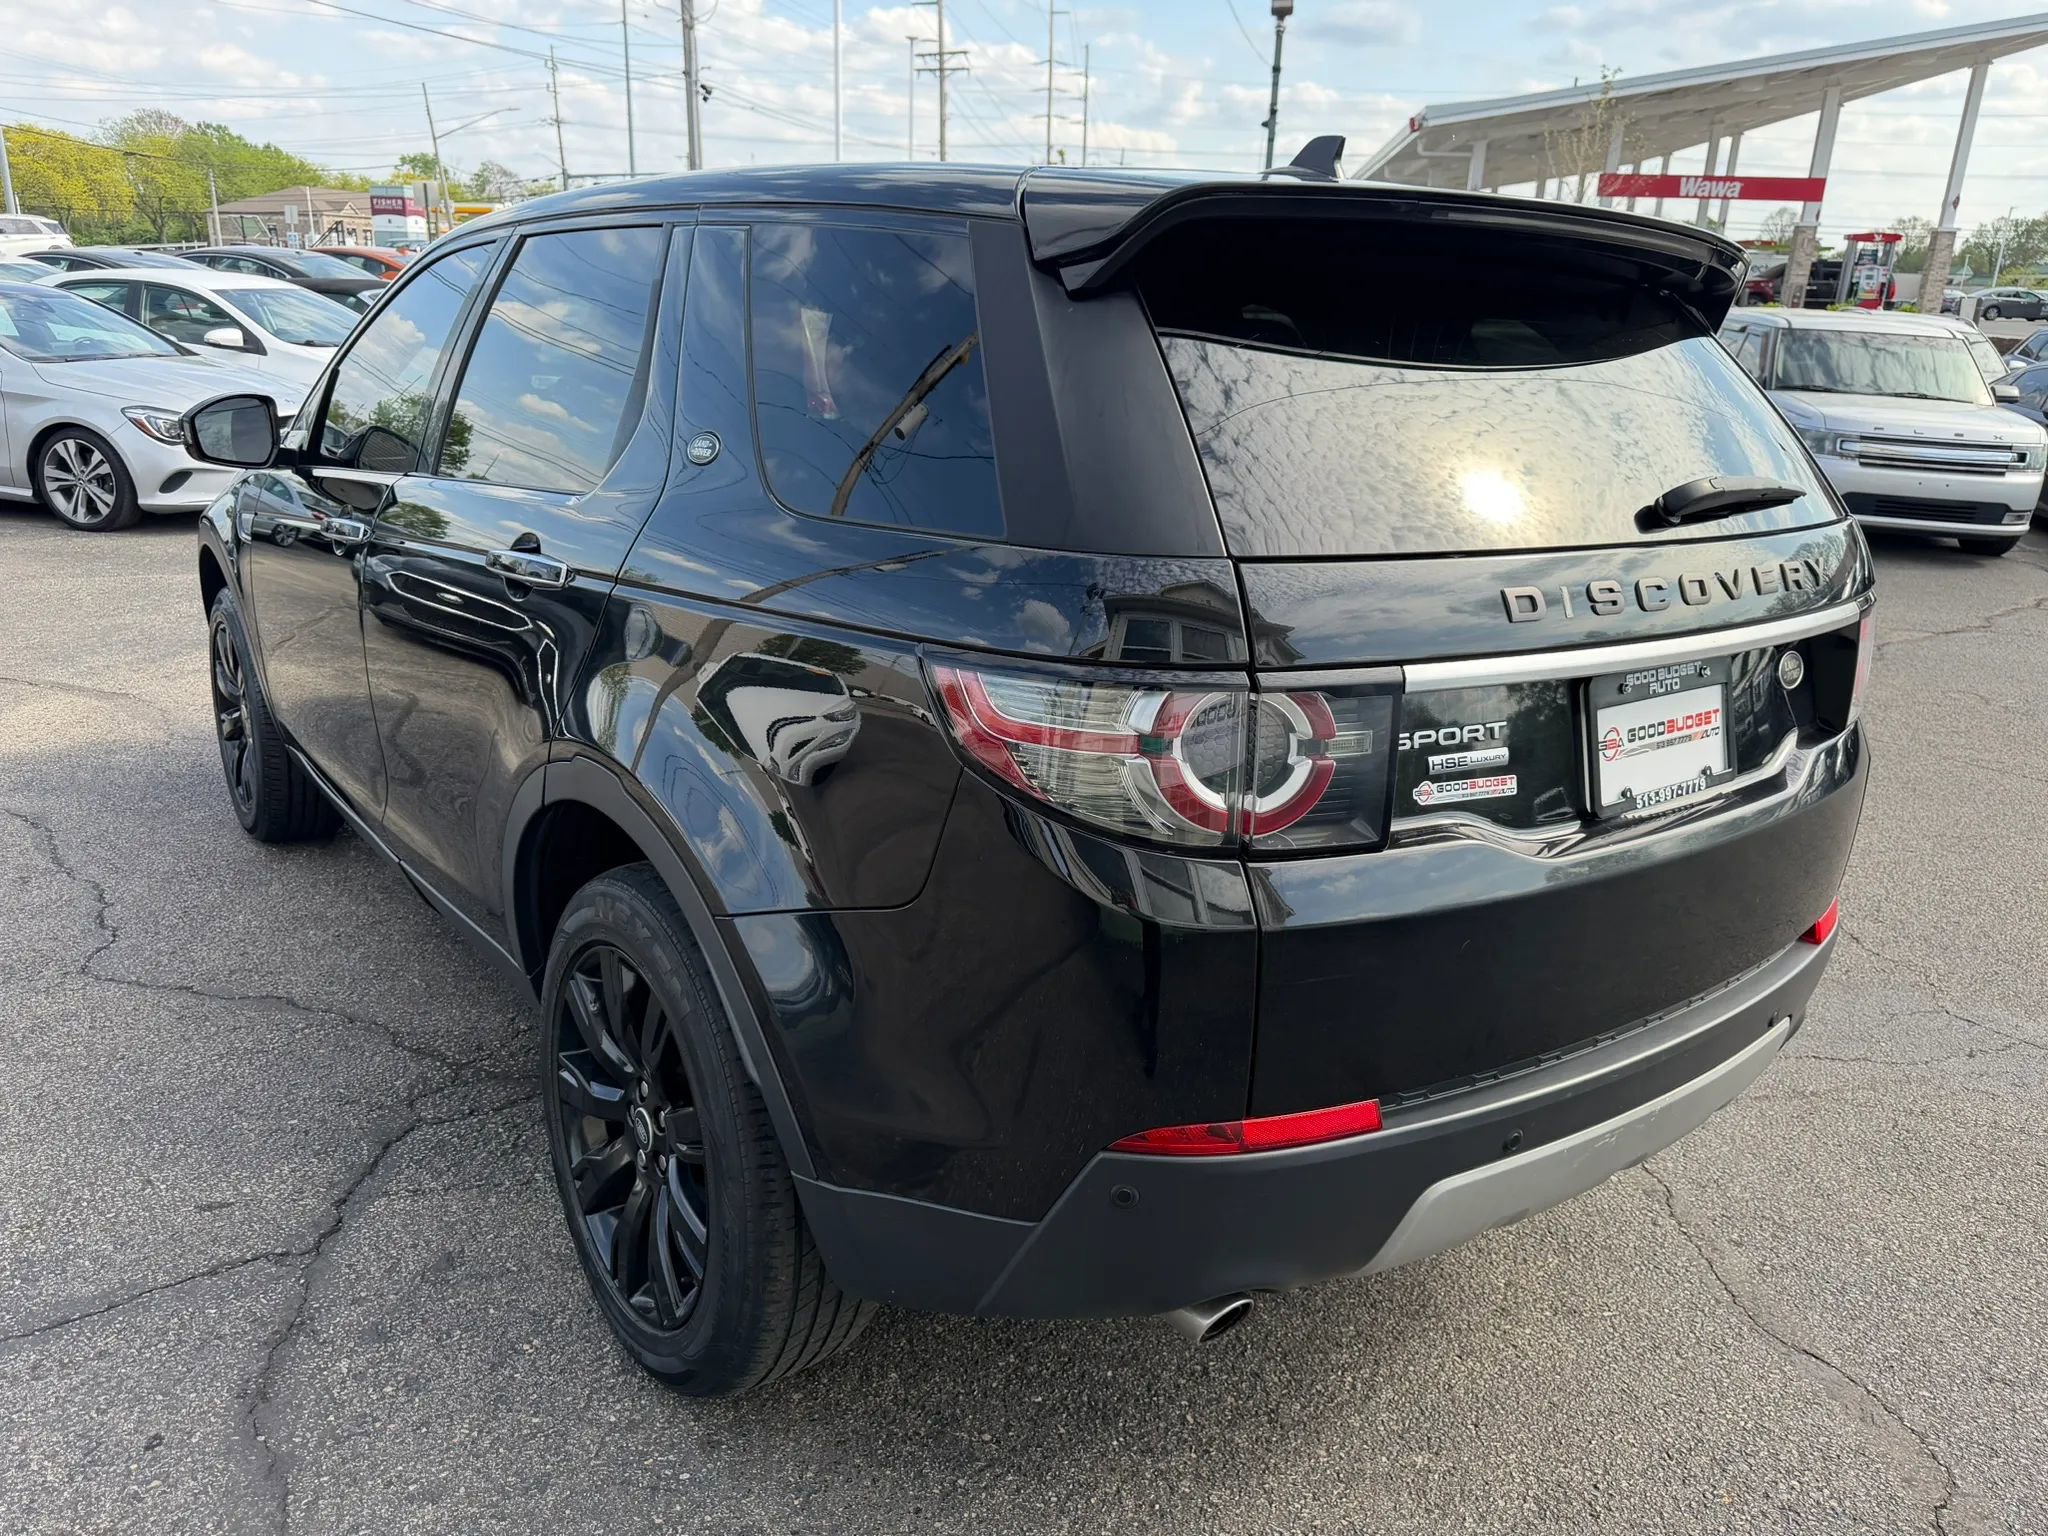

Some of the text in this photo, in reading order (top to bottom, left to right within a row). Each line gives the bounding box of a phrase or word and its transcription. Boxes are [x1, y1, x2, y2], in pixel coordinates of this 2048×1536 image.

[1679, 177, 1741, 198] Wawa
[1500, 557, 1825, 623] DISCOVERY
[1625, 661, 1702, 686] GOOD BUDGET
[1649, 678, 1681, 695] AUTO
[1398, 721, 1507, 750] SPORT
[1627, 709, 1720, 743] GOODBUDGET
[1431, 753, 1507, 771] HSE LUXURY
[1436, 776, 1516, 793] GOODBUDGET
